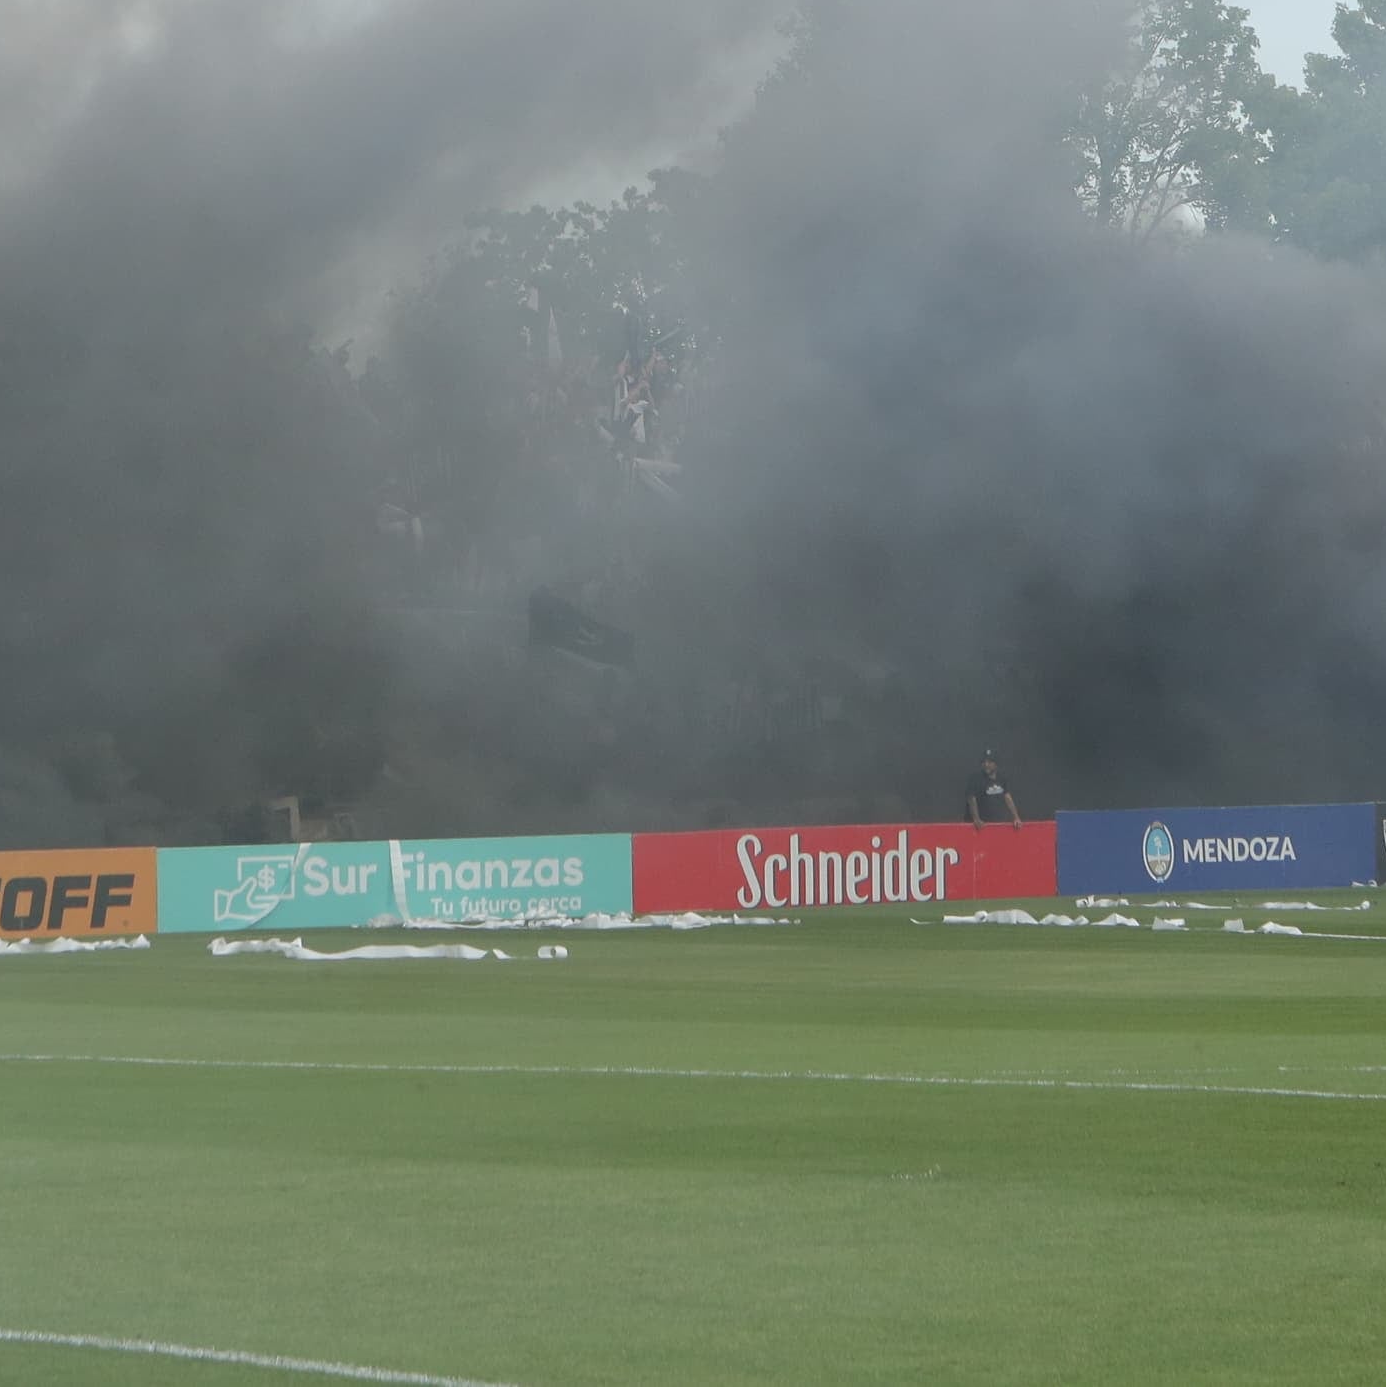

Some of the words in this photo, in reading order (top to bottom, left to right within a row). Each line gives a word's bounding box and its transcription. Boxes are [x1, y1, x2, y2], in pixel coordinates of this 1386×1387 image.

[1183, 836, 1296, 864] MENDOZA
[303, 855, 377, 896] Sur
[399, 850, 584, 891] Finanzas
[736, 829, 959, 909] Schneider
[430, 897, 454, 915] Tu
[460, 894, 521, 914] futuro
[527, 895, 582, 913] cerca
